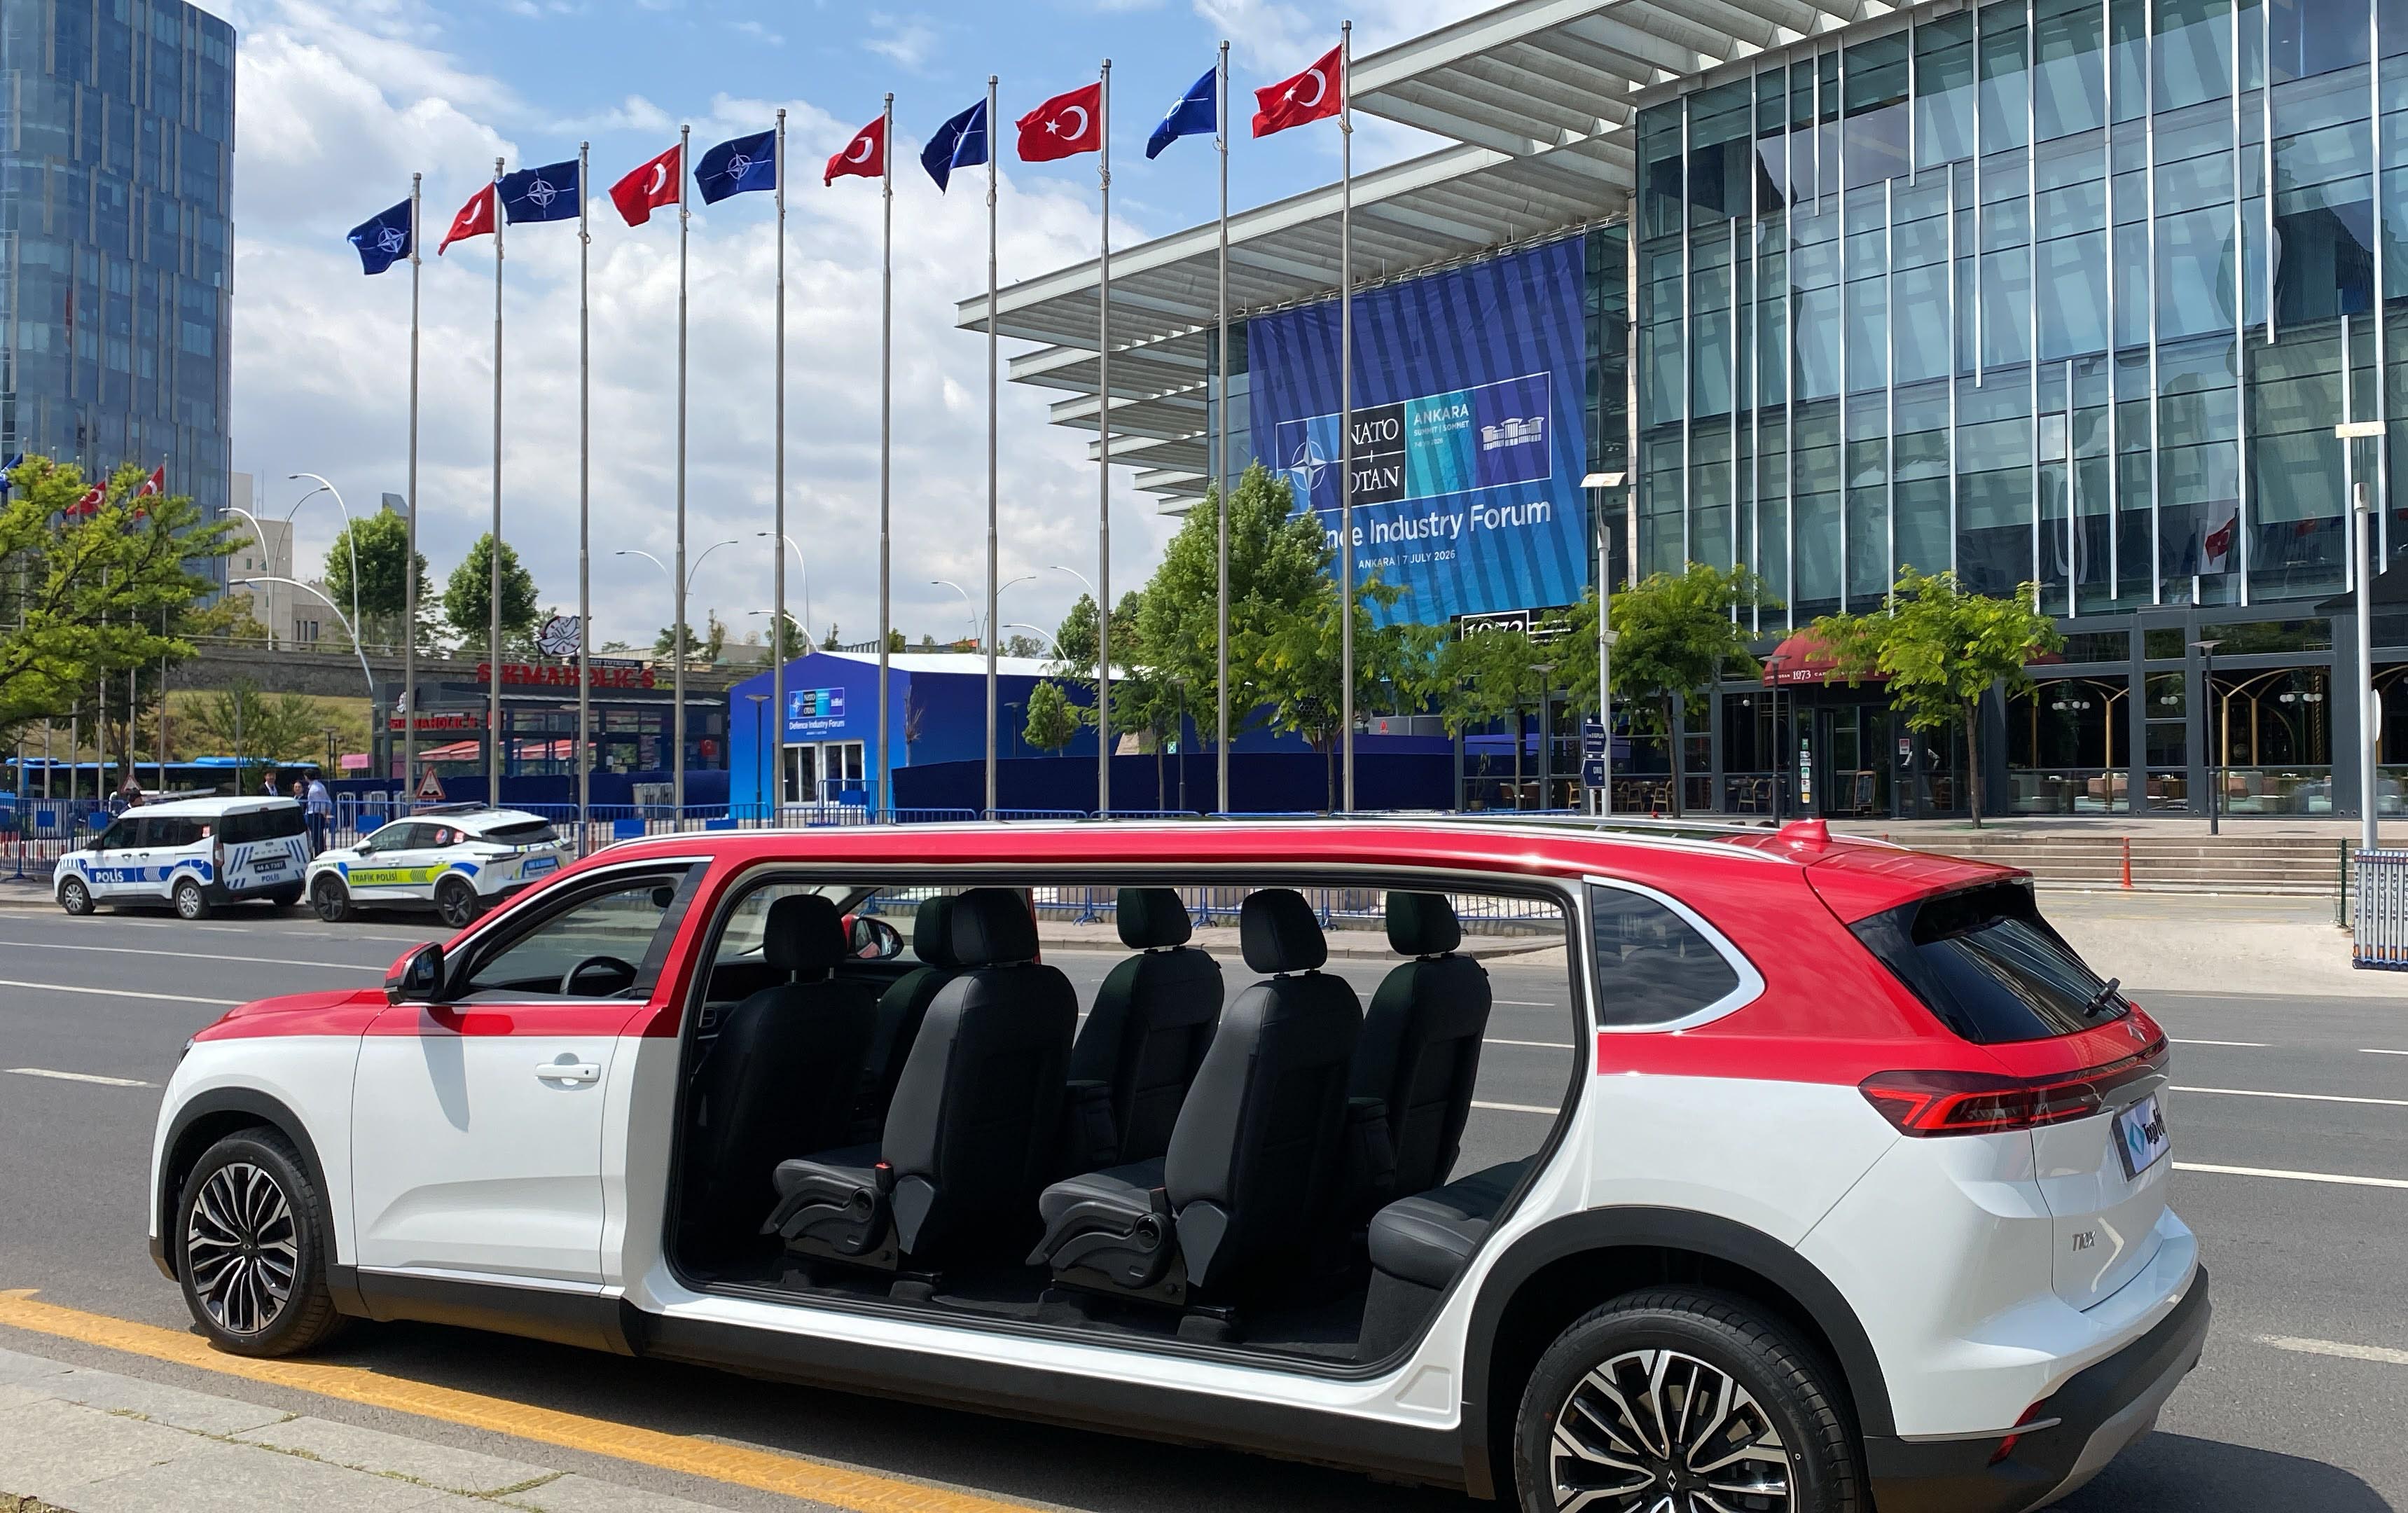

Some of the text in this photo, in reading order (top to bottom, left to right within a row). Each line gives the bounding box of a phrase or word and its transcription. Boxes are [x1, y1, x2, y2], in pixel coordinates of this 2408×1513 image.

[1413, 403, 1469, 426] ANKARA
[1350, 418, 1399, 445] NATO
[1413, 420, 1469, 436] SUMMIT SOMMET
[1370, 512, 1464, 544] Industry
[1469, 501, 1551, 532] Forum
[1358, 549, 1455, 569] ANKARA 7 JULY 2026
[789, 719, 845, 730] Defence Industry Forum
